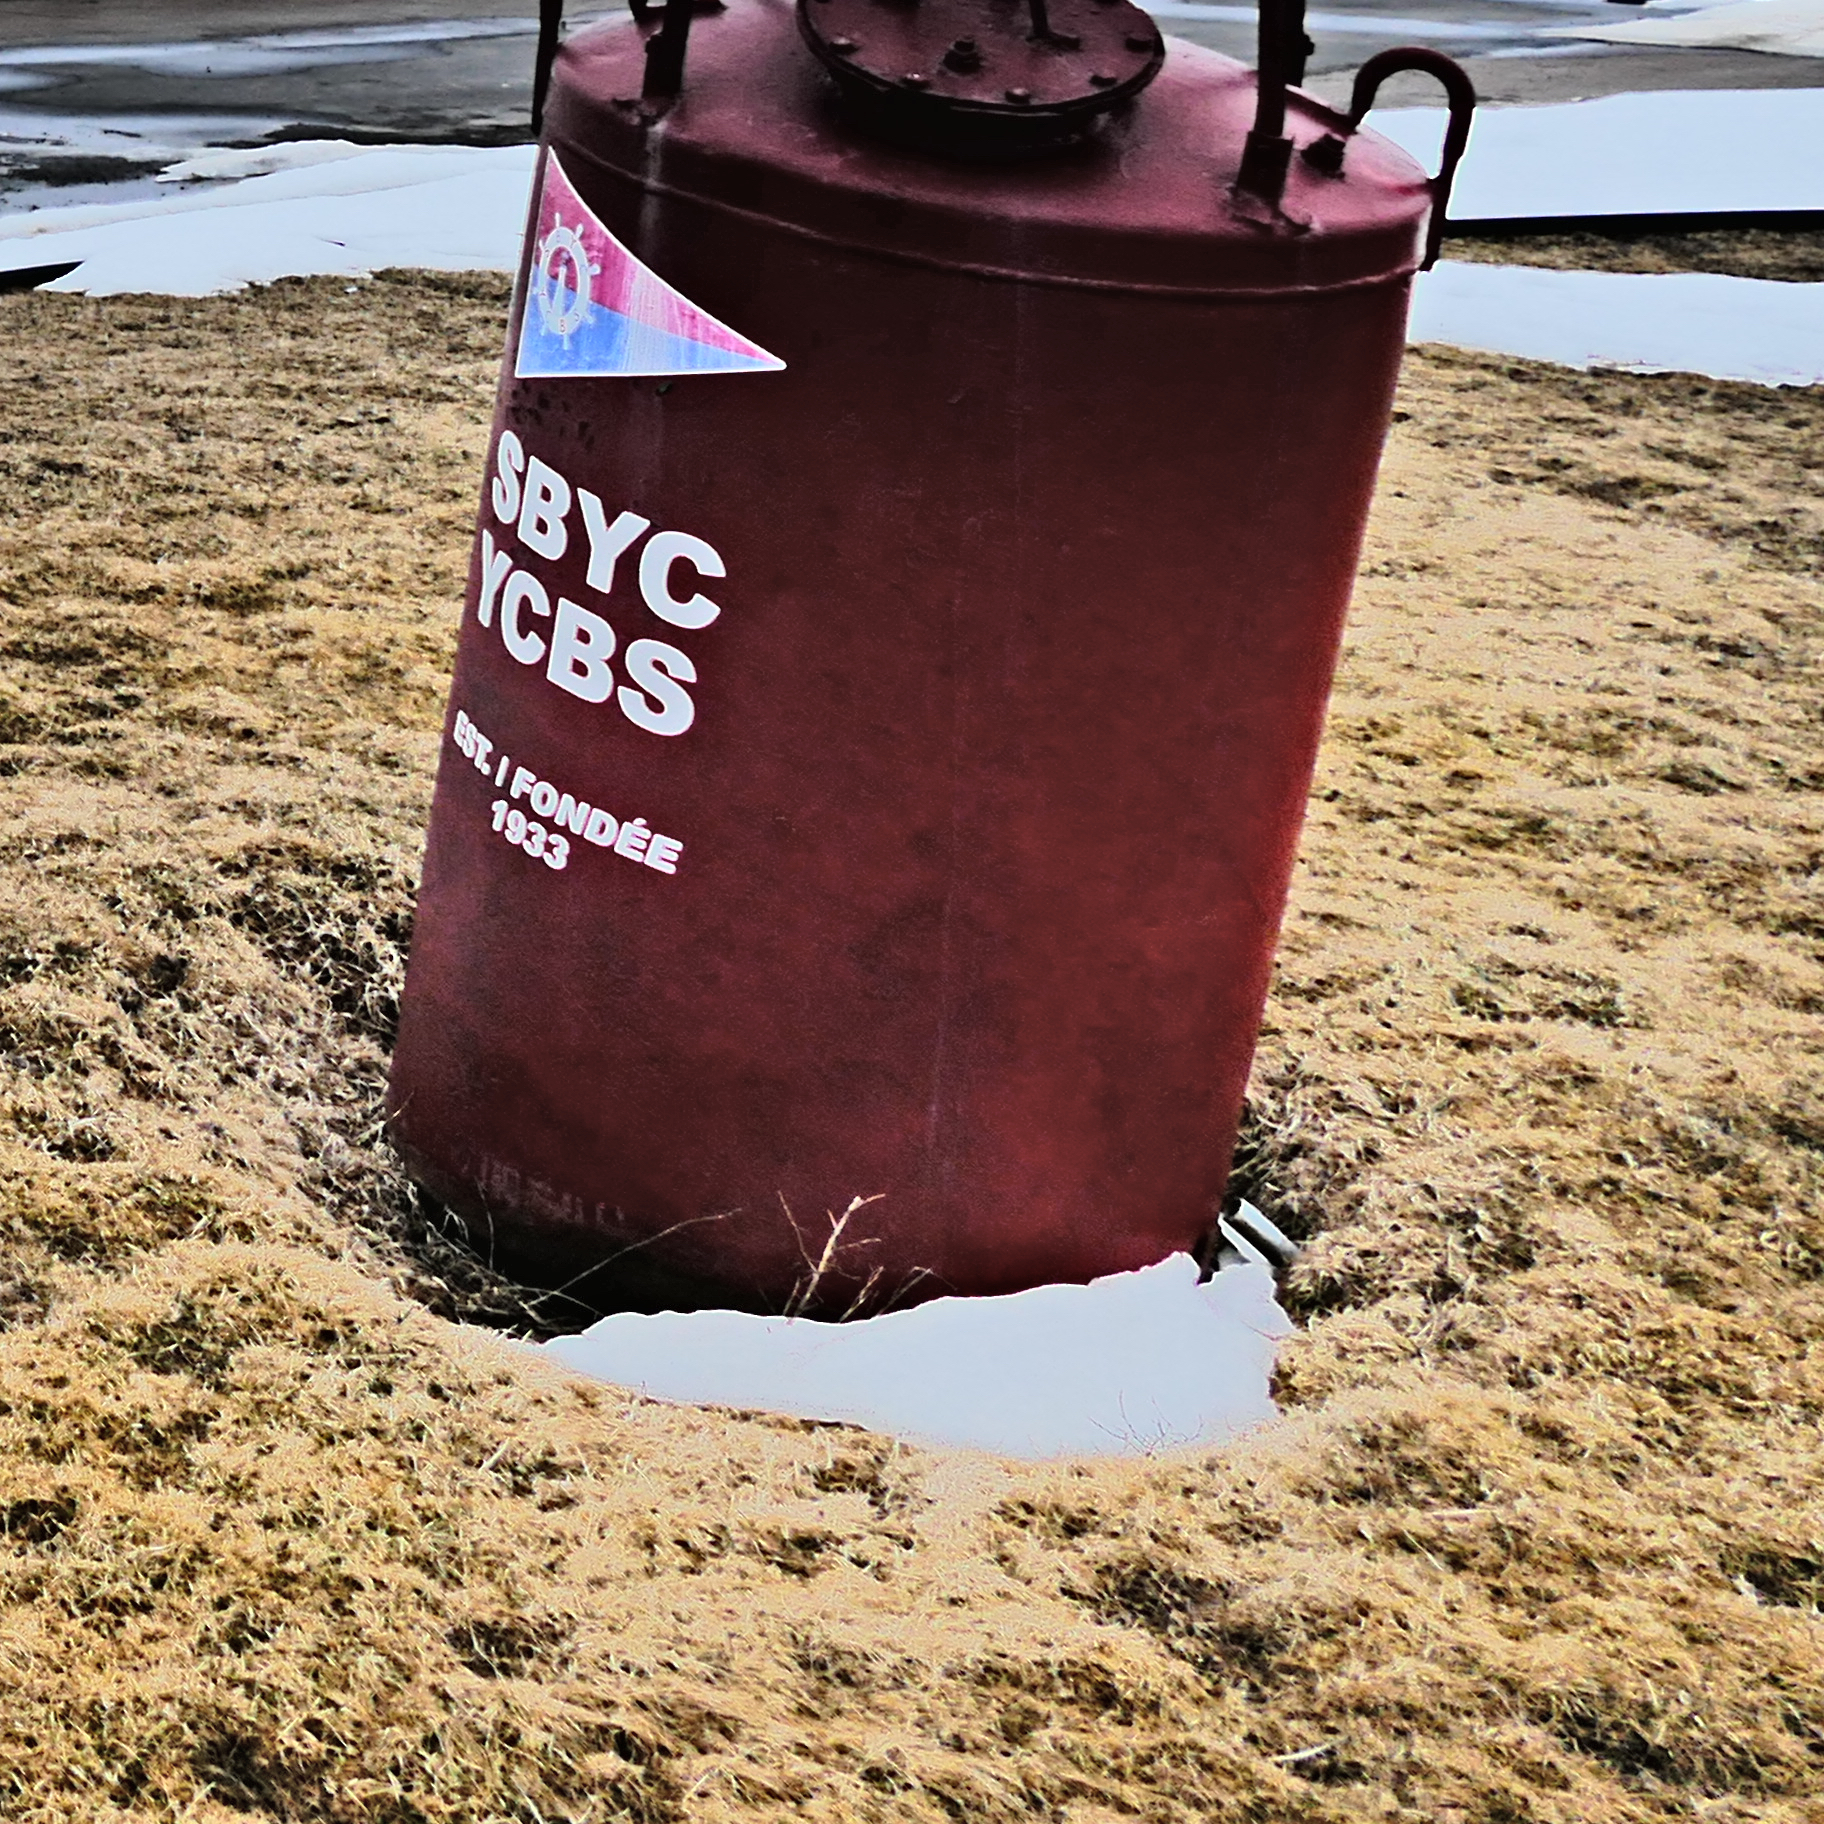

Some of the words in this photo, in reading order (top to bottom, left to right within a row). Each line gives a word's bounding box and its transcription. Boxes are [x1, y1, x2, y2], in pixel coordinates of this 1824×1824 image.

[491, 429, 727, 630] SBYC
[477, 528, 698, 737] YCBS
[453, 709, 493, 776] EST.
[509, 766, 684, 875] FONDÉE
[491, 799, 570, 870] 1933
